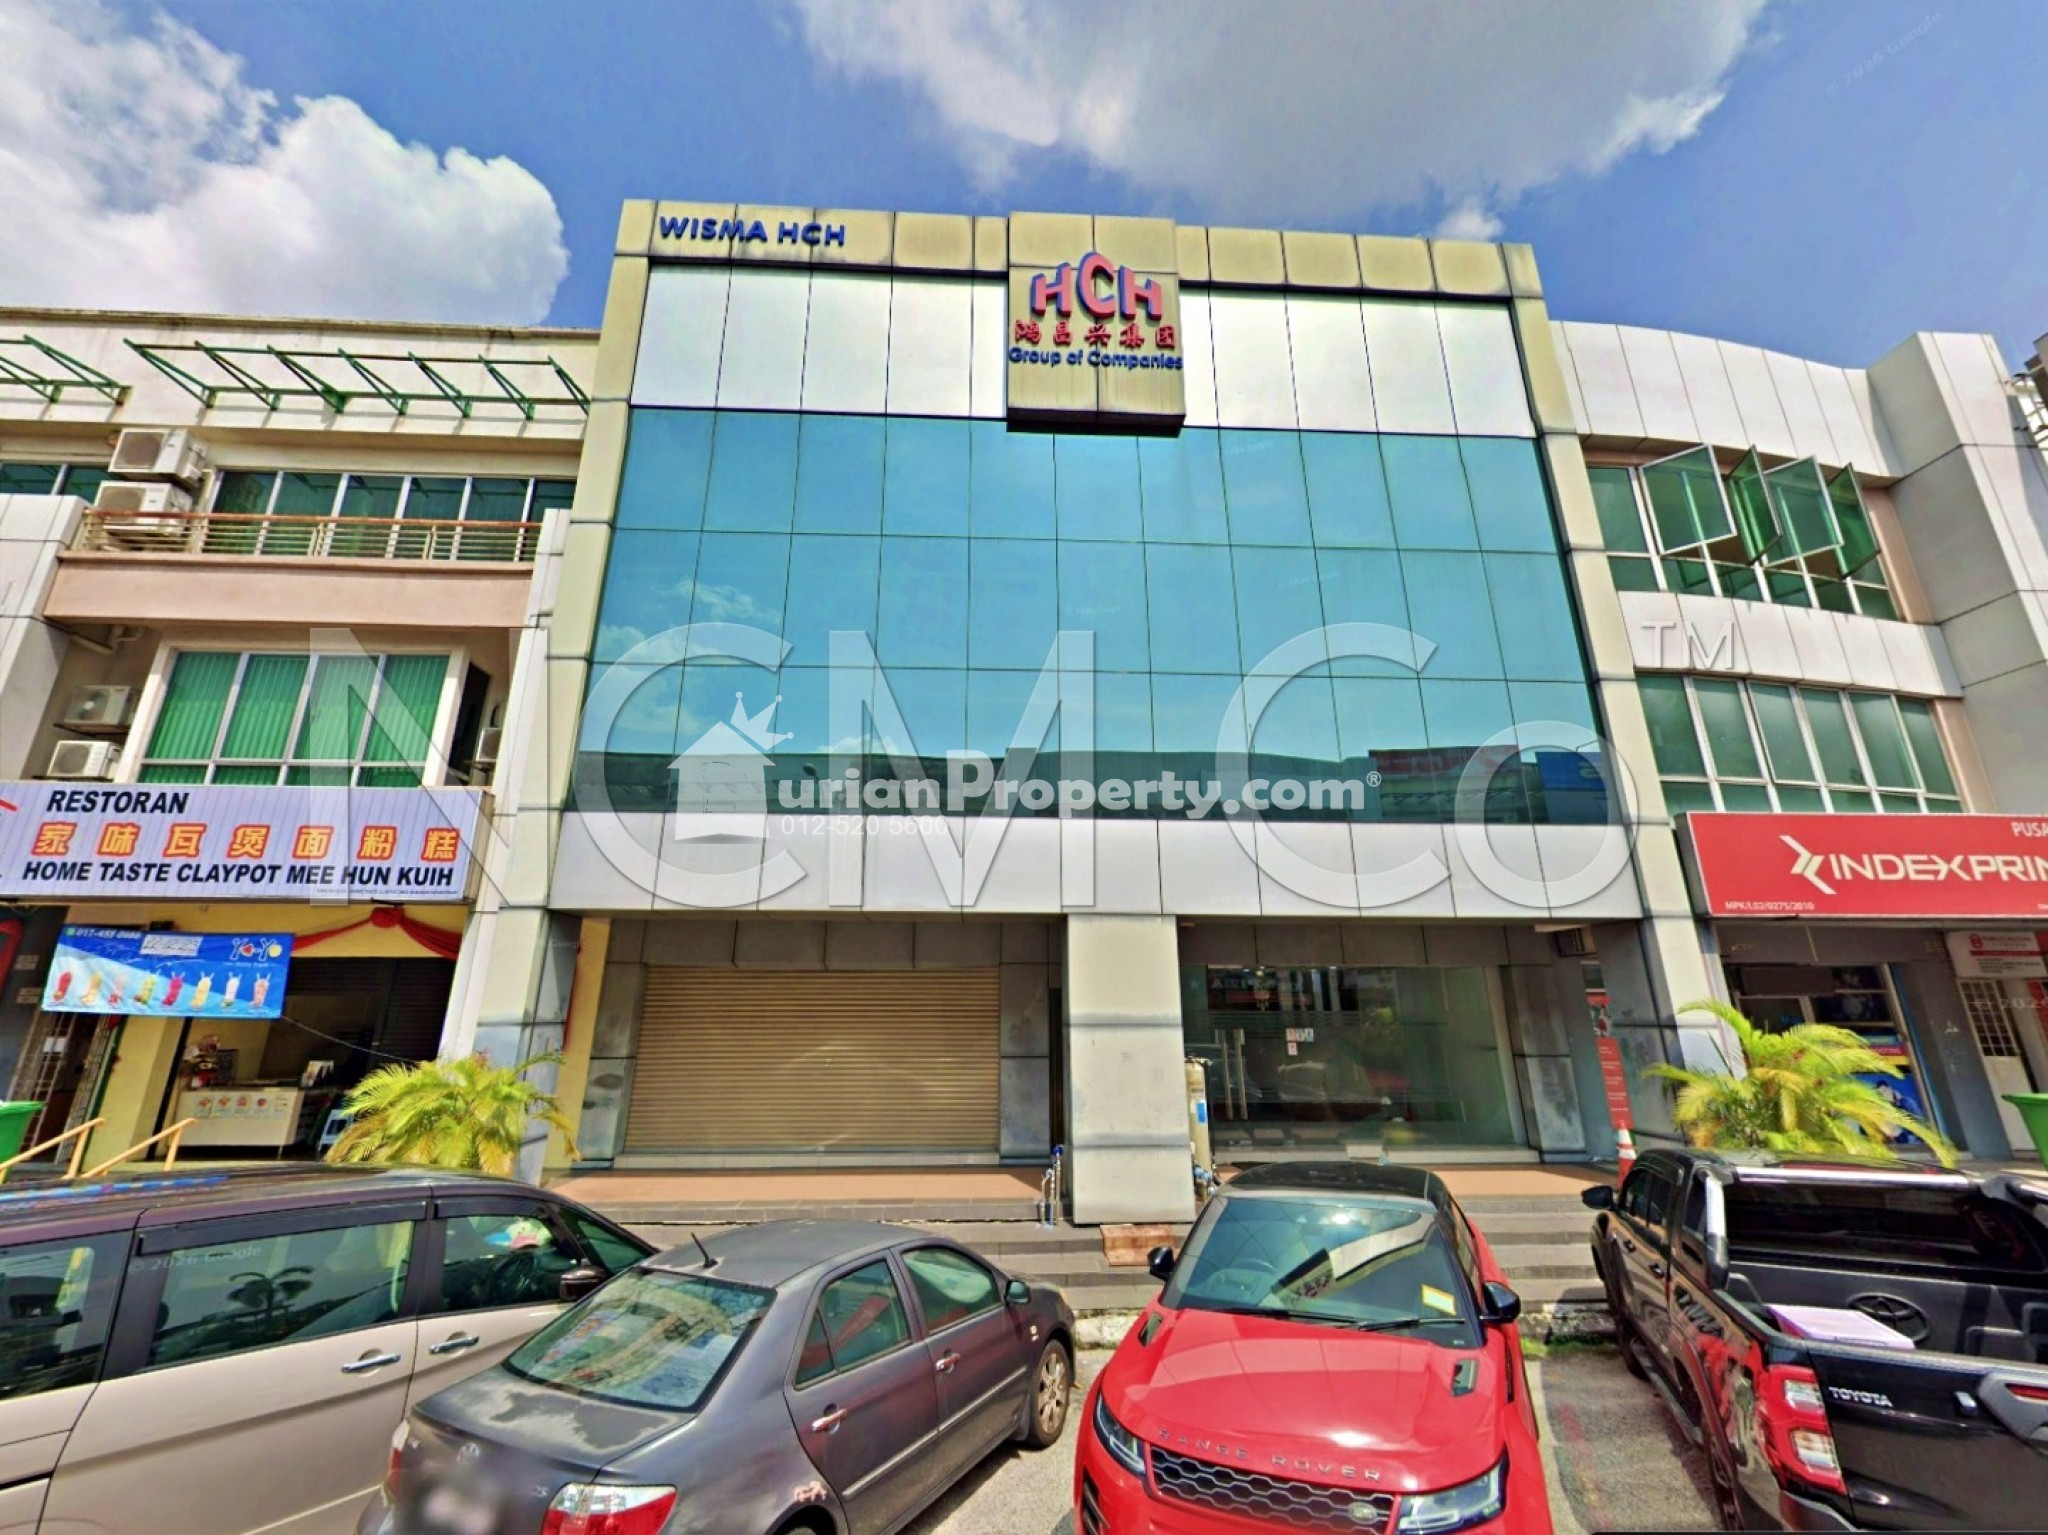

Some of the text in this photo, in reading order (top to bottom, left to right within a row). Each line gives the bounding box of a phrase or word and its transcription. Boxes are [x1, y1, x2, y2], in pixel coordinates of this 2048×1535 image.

[659, 216, 846, 246] WISMA HCH
[1030, 251, 1163, 321] HCH
[1008, 347, 1183, 370] Group of Companies
[47, 790, 189, 814] RESTORAN
[31, 821, 461, 862] 家味瓦煲面粉糕
[22, 862, 453, 886] HOME TASTE CLAYPOT MEE HUN KUIH
[1828, 1386, 1893, 1408] TOYOTA
[1158, 1429, 1381, 1482] RANGE ROVER
